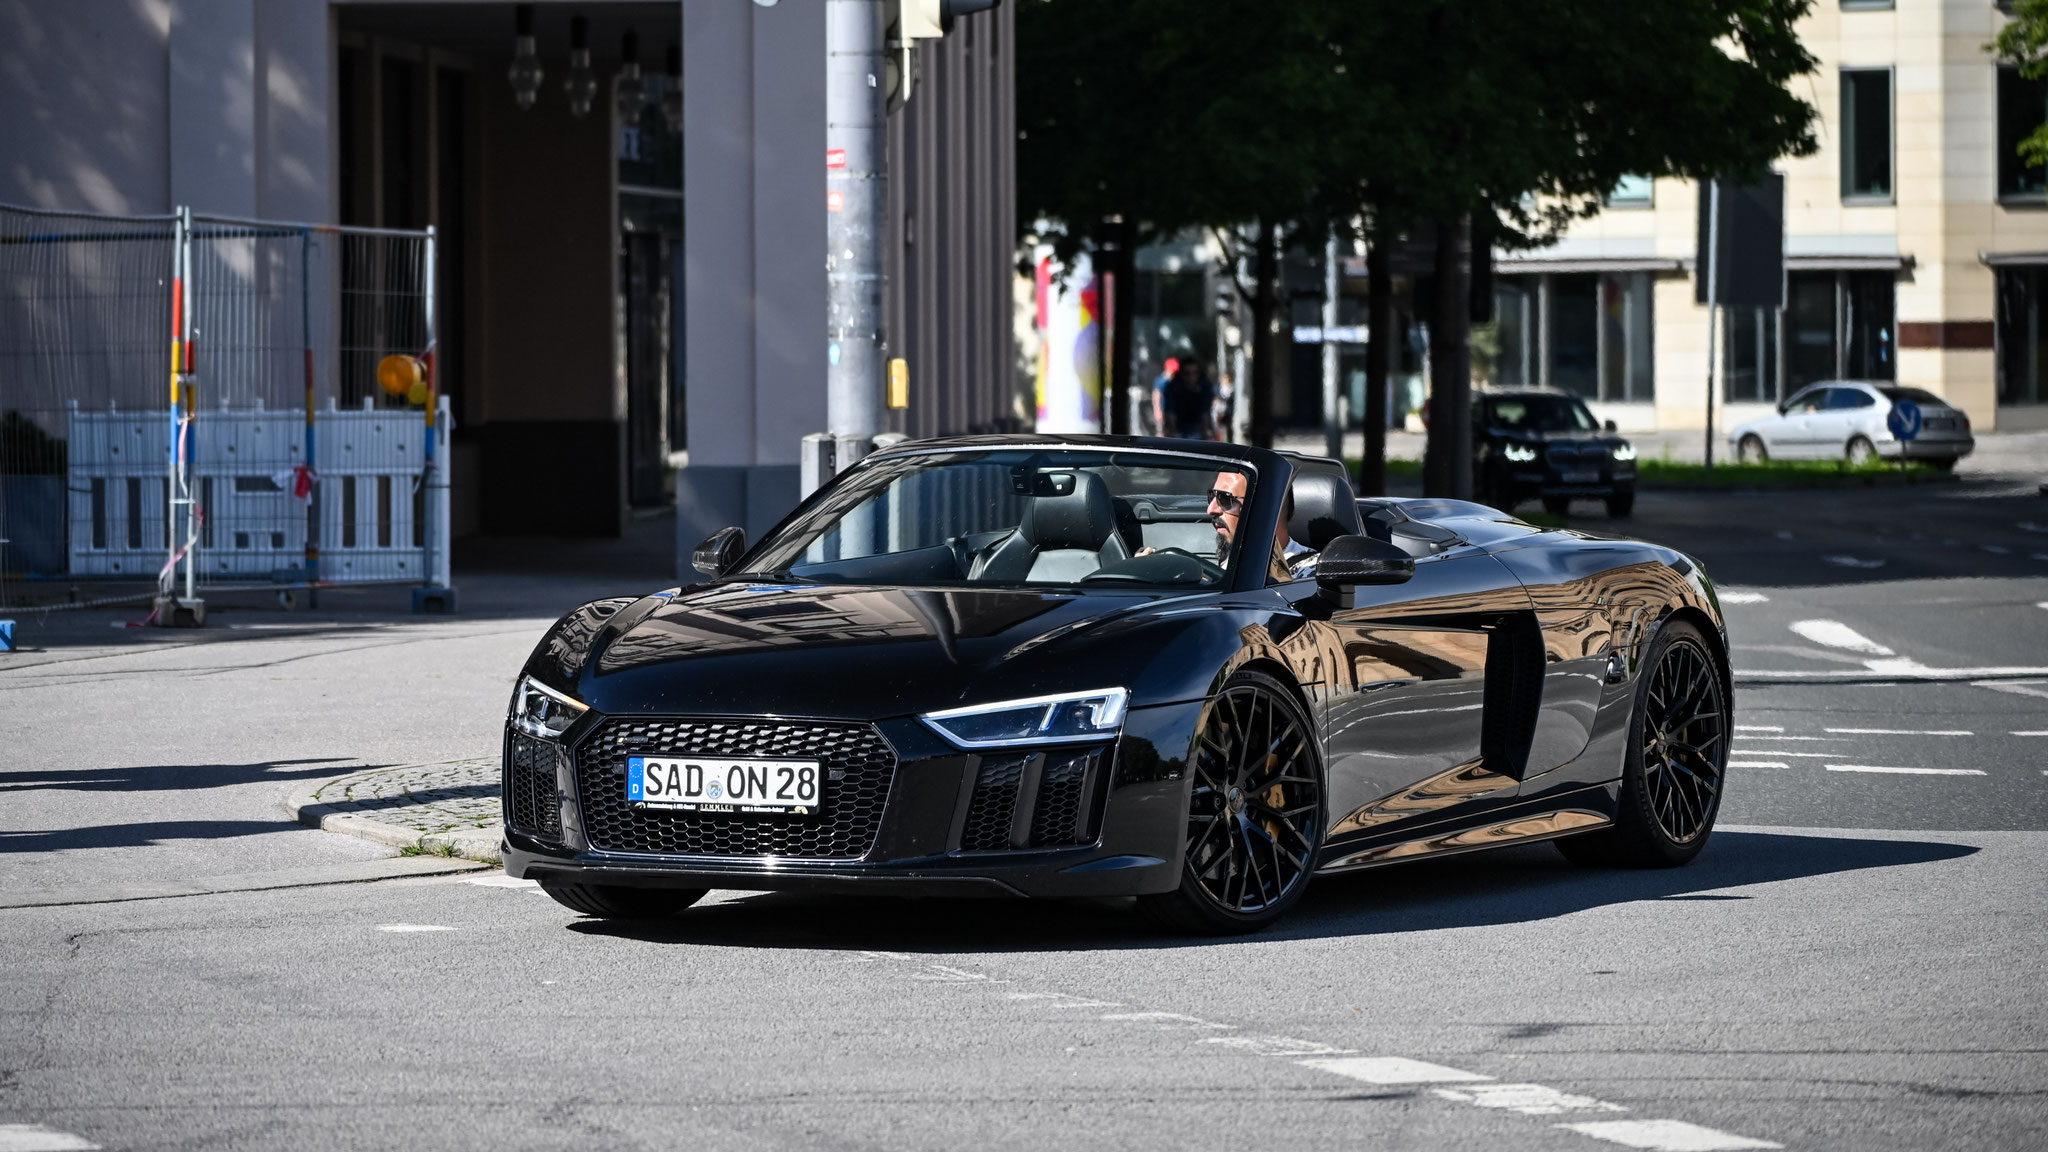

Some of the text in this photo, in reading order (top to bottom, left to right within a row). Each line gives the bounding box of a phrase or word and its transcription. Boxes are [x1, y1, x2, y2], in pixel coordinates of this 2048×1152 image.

[632, 783, 639, 794] D
[645, 762, 816, 801] SAD ON 28
